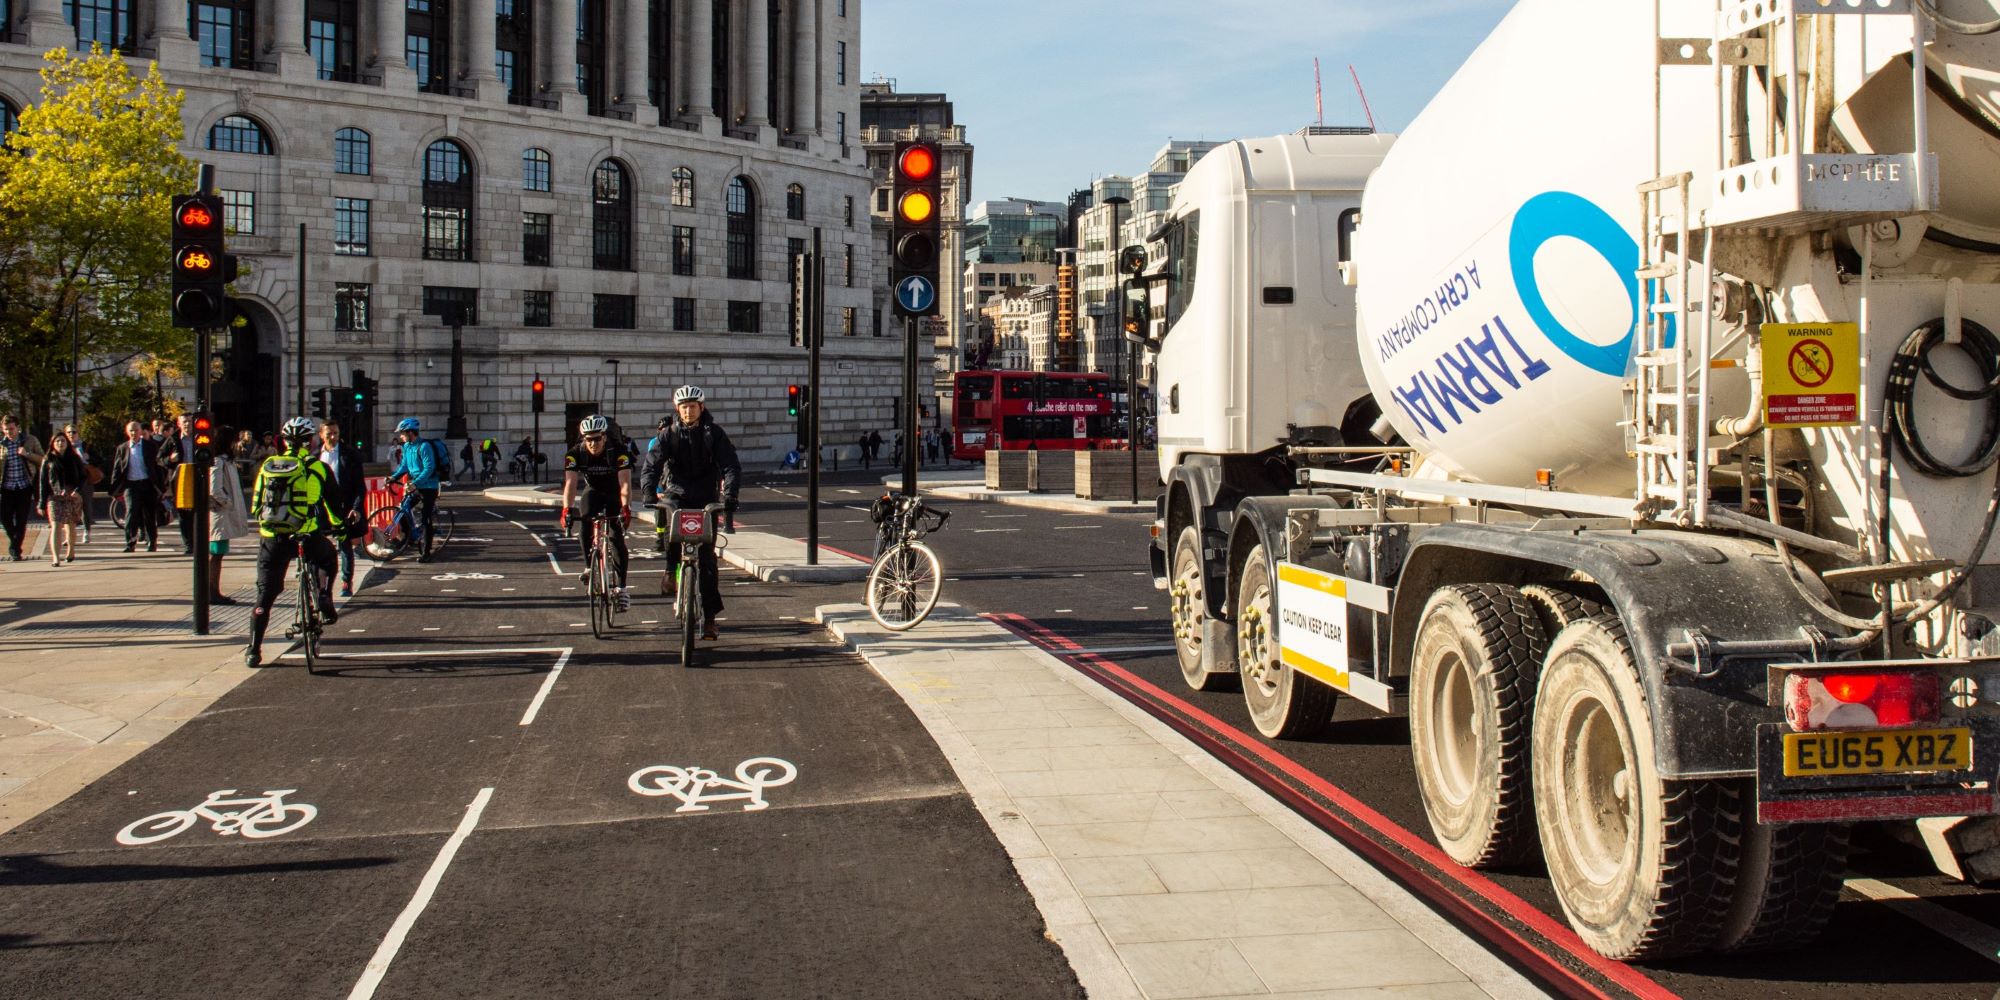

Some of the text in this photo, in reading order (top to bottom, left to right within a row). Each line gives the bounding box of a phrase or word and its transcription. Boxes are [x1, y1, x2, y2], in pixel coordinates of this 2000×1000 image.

[1377, 259, 1481, 364] A CRH COMPANY
[1788, 328, 1833, 336] WARNING
[1055, 402, 1067, 412] relief
[1068, 404, 1075, 412] on
[1075, 402, 1084, 412] the
[1283, 608, 1342, 643] CAUTION KEEP CLEAR
[1797, 734, 1957, 770] EU65 XBZ
